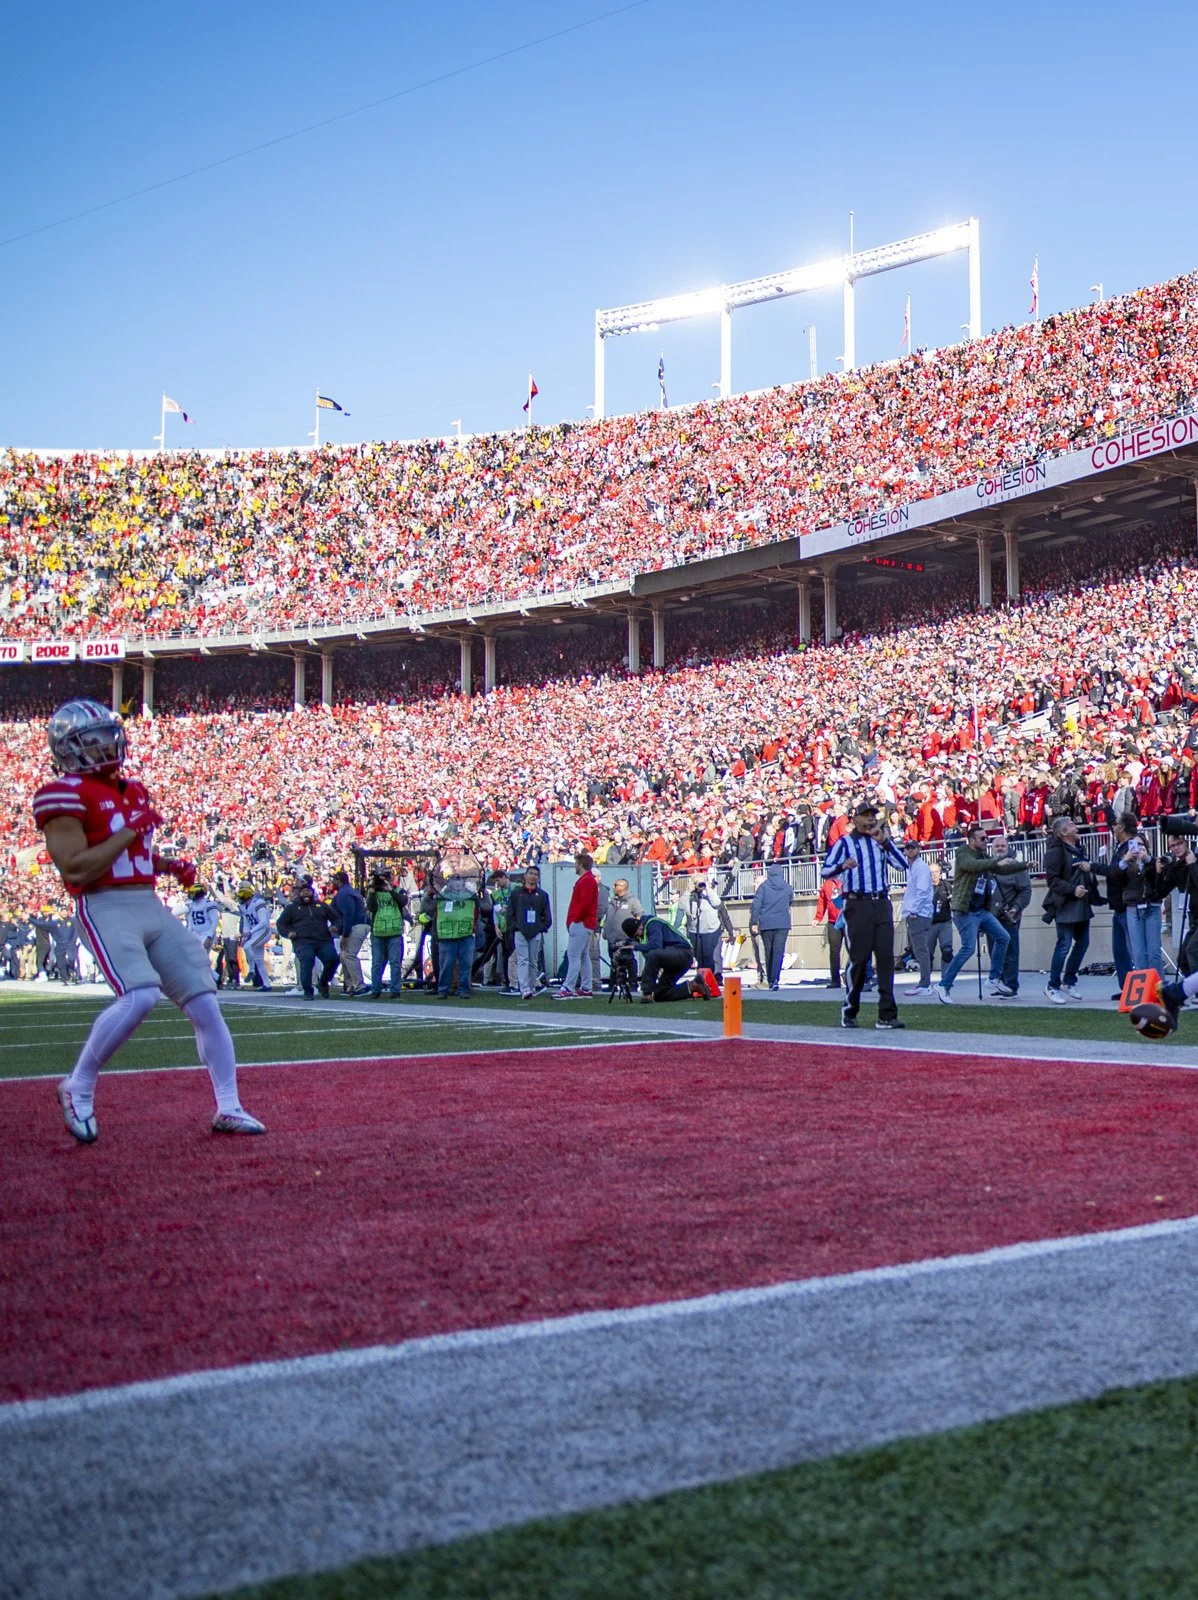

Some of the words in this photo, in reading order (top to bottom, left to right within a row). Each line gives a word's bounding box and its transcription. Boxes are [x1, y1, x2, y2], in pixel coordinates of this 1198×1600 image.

[976, 463, 1046, 498] COHESION
[847, 506, 909, 537] COHESION
[36, 645, 70, 658] 2002
[86, 643, 119, 657] 2014
[1125, 973, 1147, 1007] G
